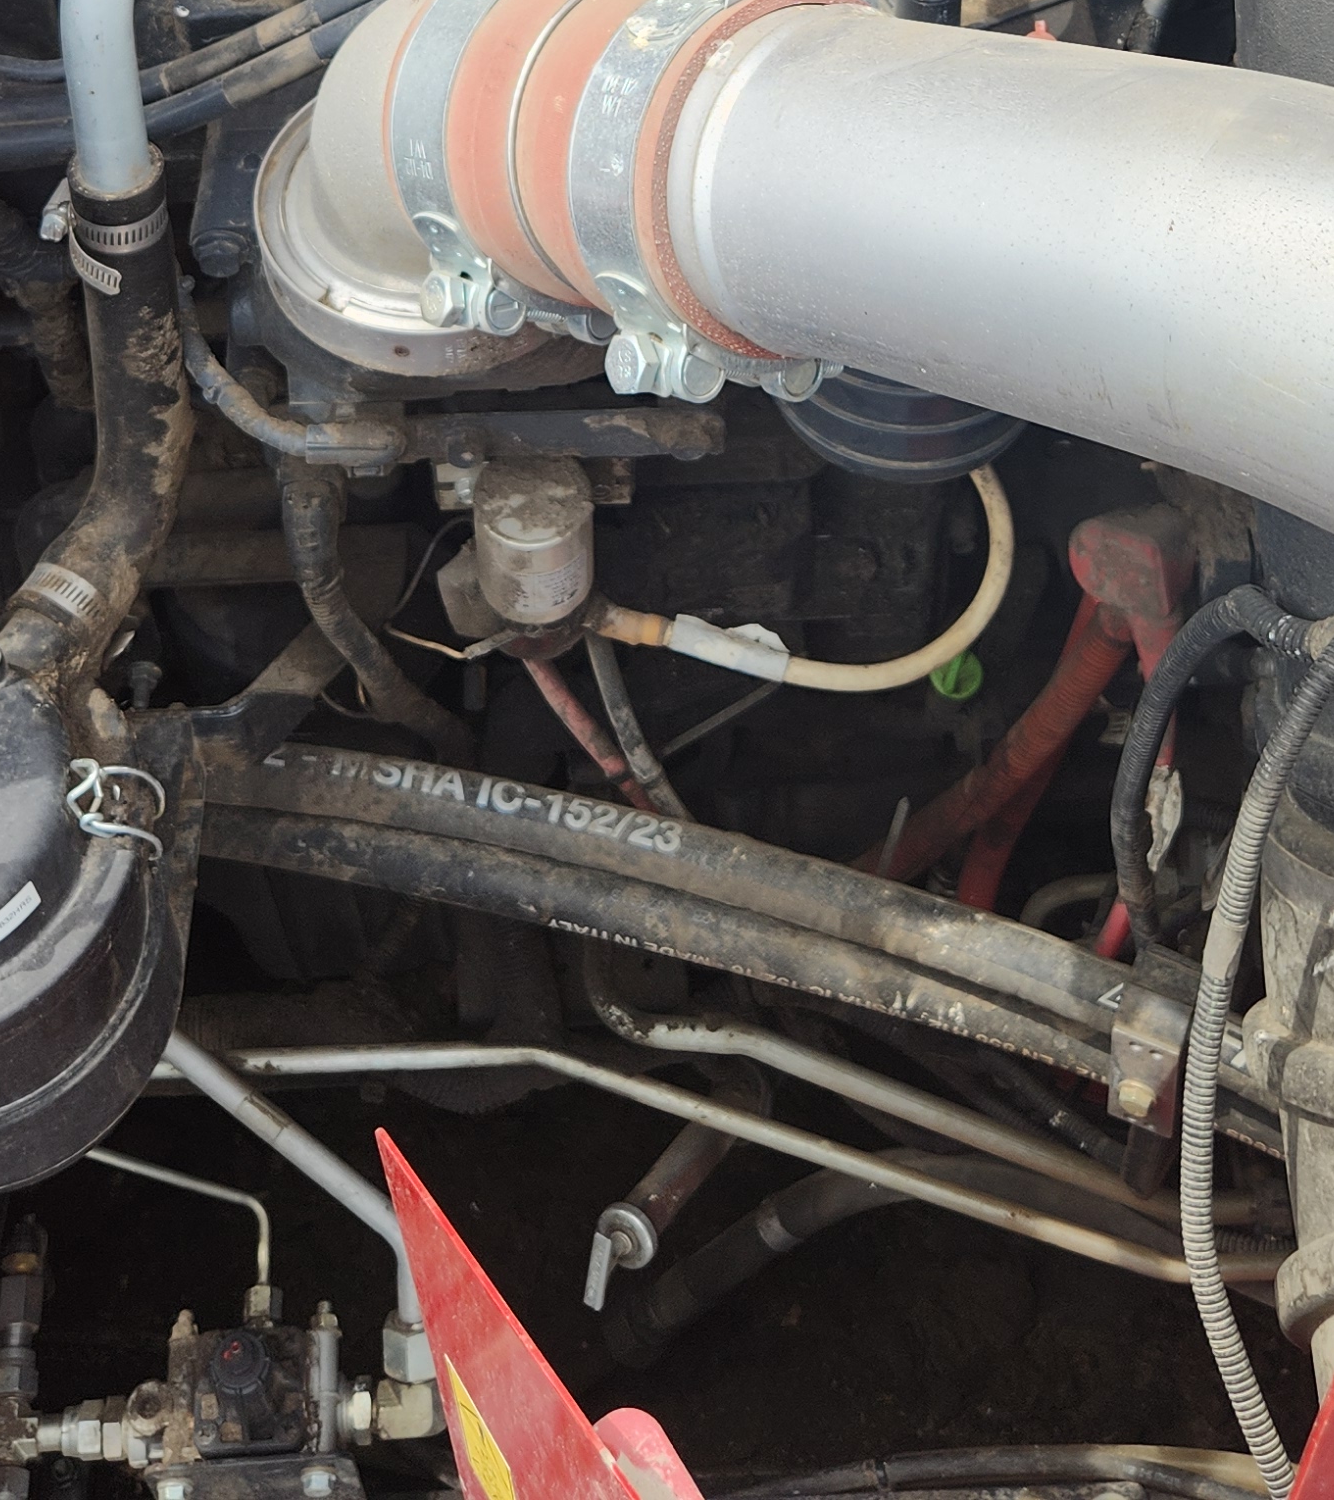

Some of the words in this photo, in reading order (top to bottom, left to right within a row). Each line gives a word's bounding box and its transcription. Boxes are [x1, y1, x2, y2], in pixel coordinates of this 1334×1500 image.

[475, 778, 684, 855] IC-152/23
[547, 917, 610, 942] ITALY
[613, 931, 638, 949] IN
